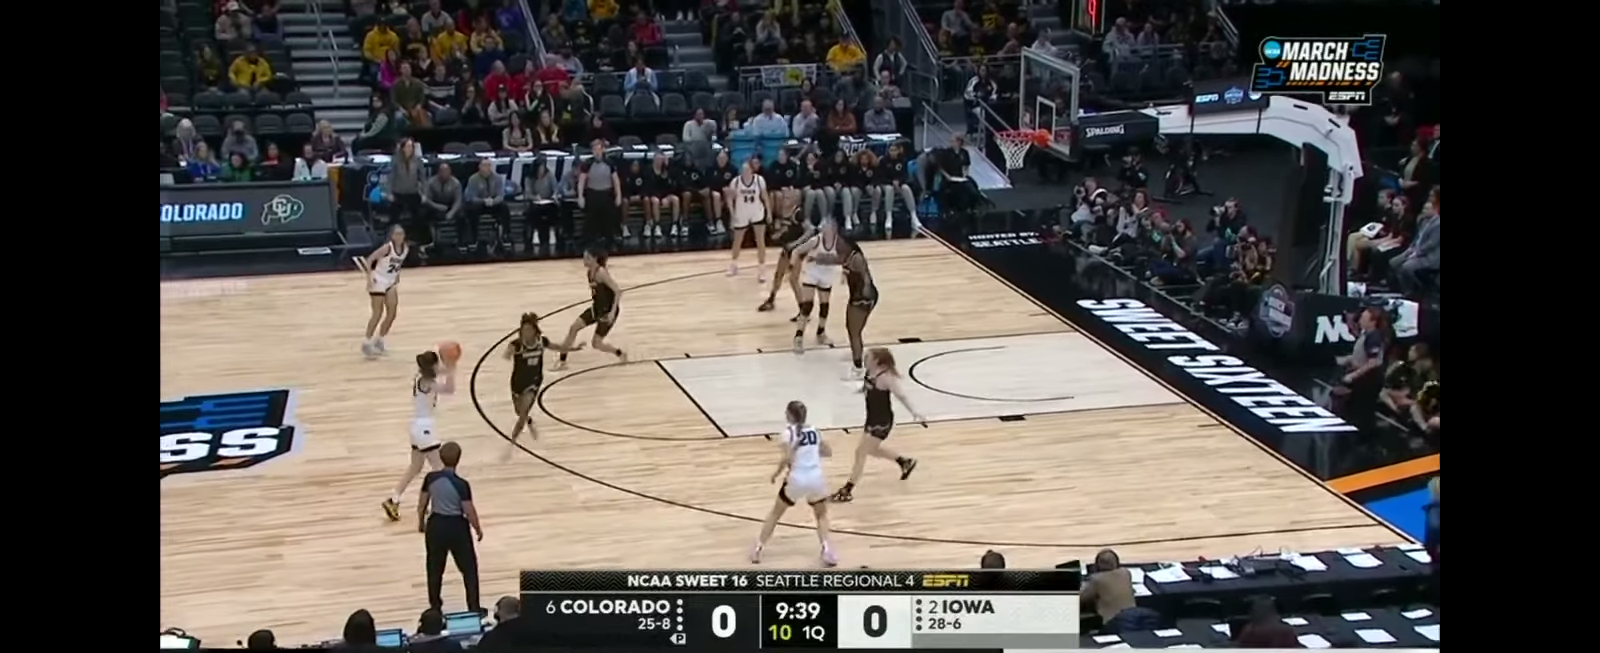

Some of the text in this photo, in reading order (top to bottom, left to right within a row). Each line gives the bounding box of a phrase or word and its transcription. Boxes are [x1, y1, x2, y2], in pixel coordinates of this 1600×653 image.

[1085, 124, 1125, 138] SPALDING
[160, 202, 244, 222] OLORADO
[970, 238, 1043, 248] SEATTLE
[1075, 298, 1221, 351] SWEET
[1166, 354, 1360, 433] SIXTEEN
[799, 430, 818, 447] 20
